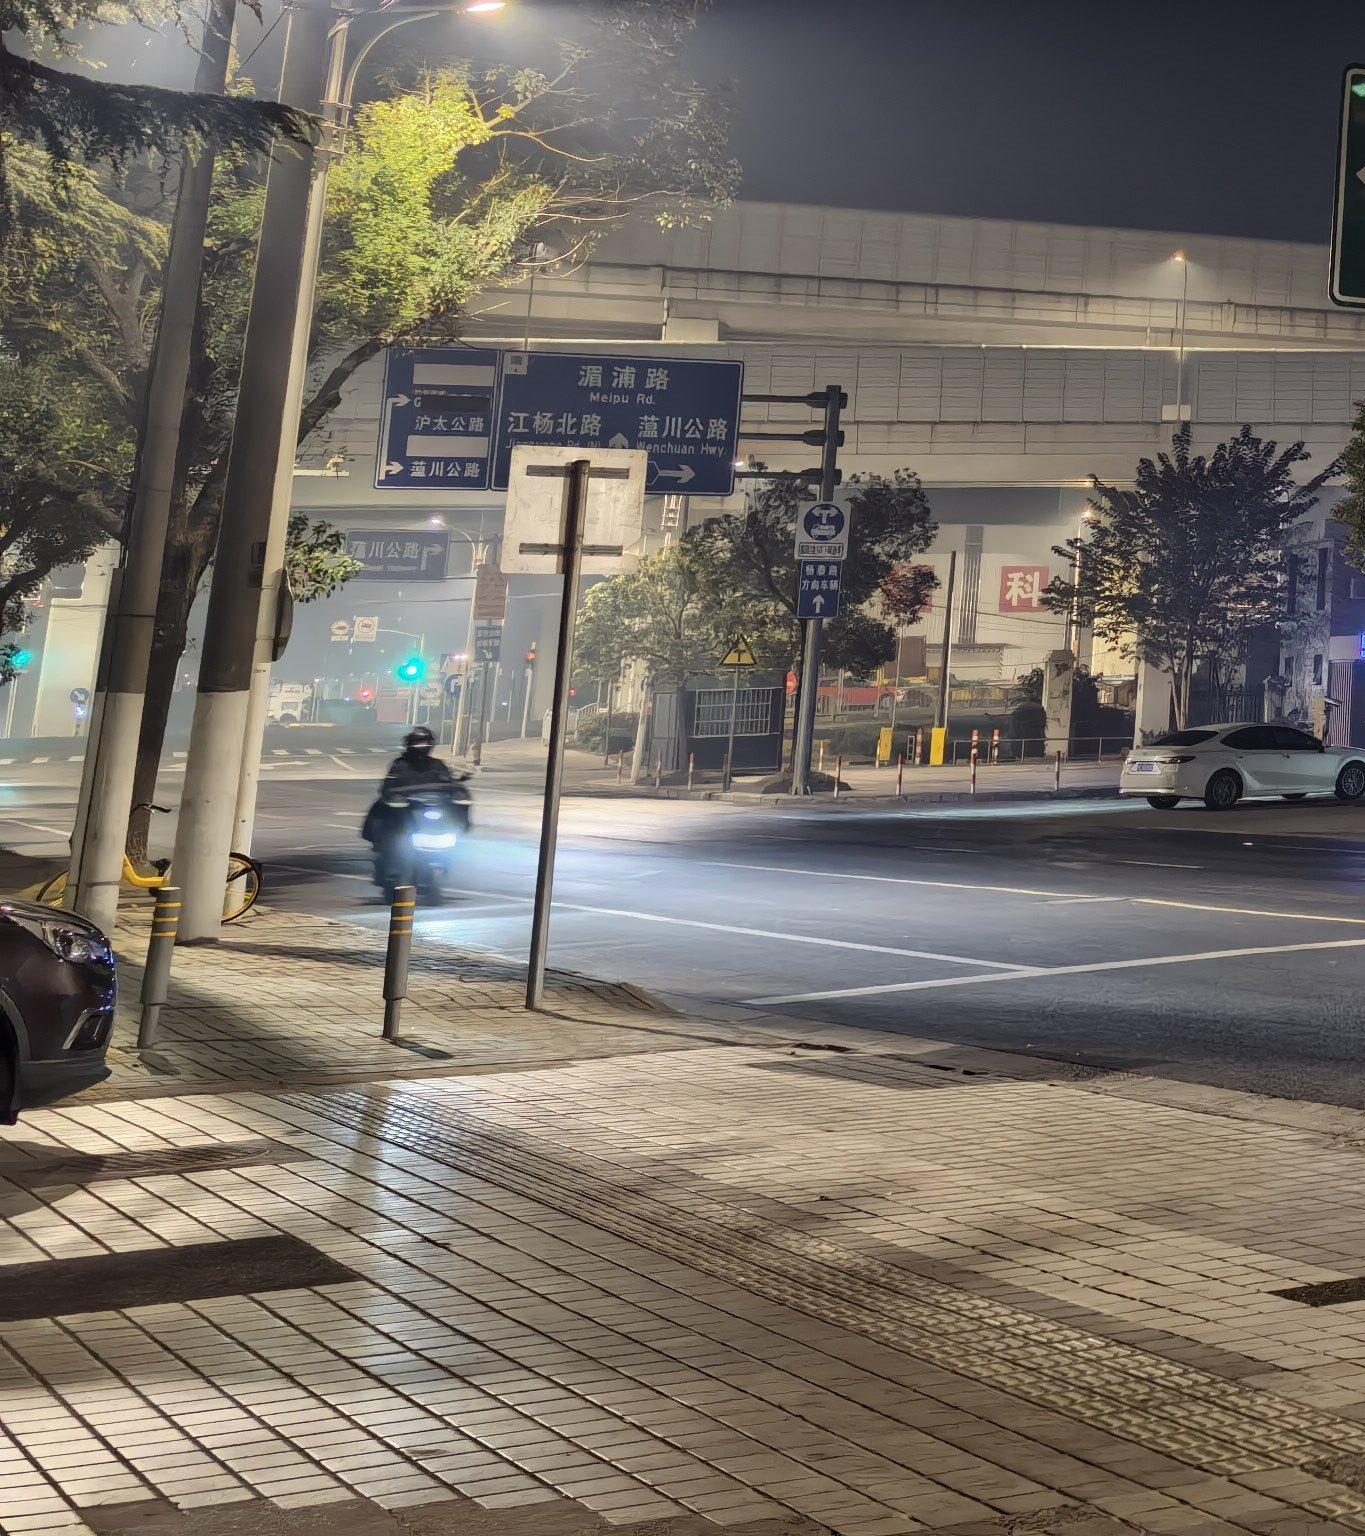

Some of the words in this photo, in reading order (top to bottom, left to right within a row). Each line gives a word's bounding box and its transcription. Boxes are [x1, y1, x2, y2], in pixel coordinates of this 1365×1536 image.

[577, 365, 670, 391] 湄浦路
[589, 392, 629, 405] Meipu
[636, 394, 656, 406] Rd.
[414, 414, 485, 433] 沪太公路
[507, 411, 602, 437] 江杨北路
[701, 443, 728, 459] Hwy.
[1005, 571, 1043, 608] 科
